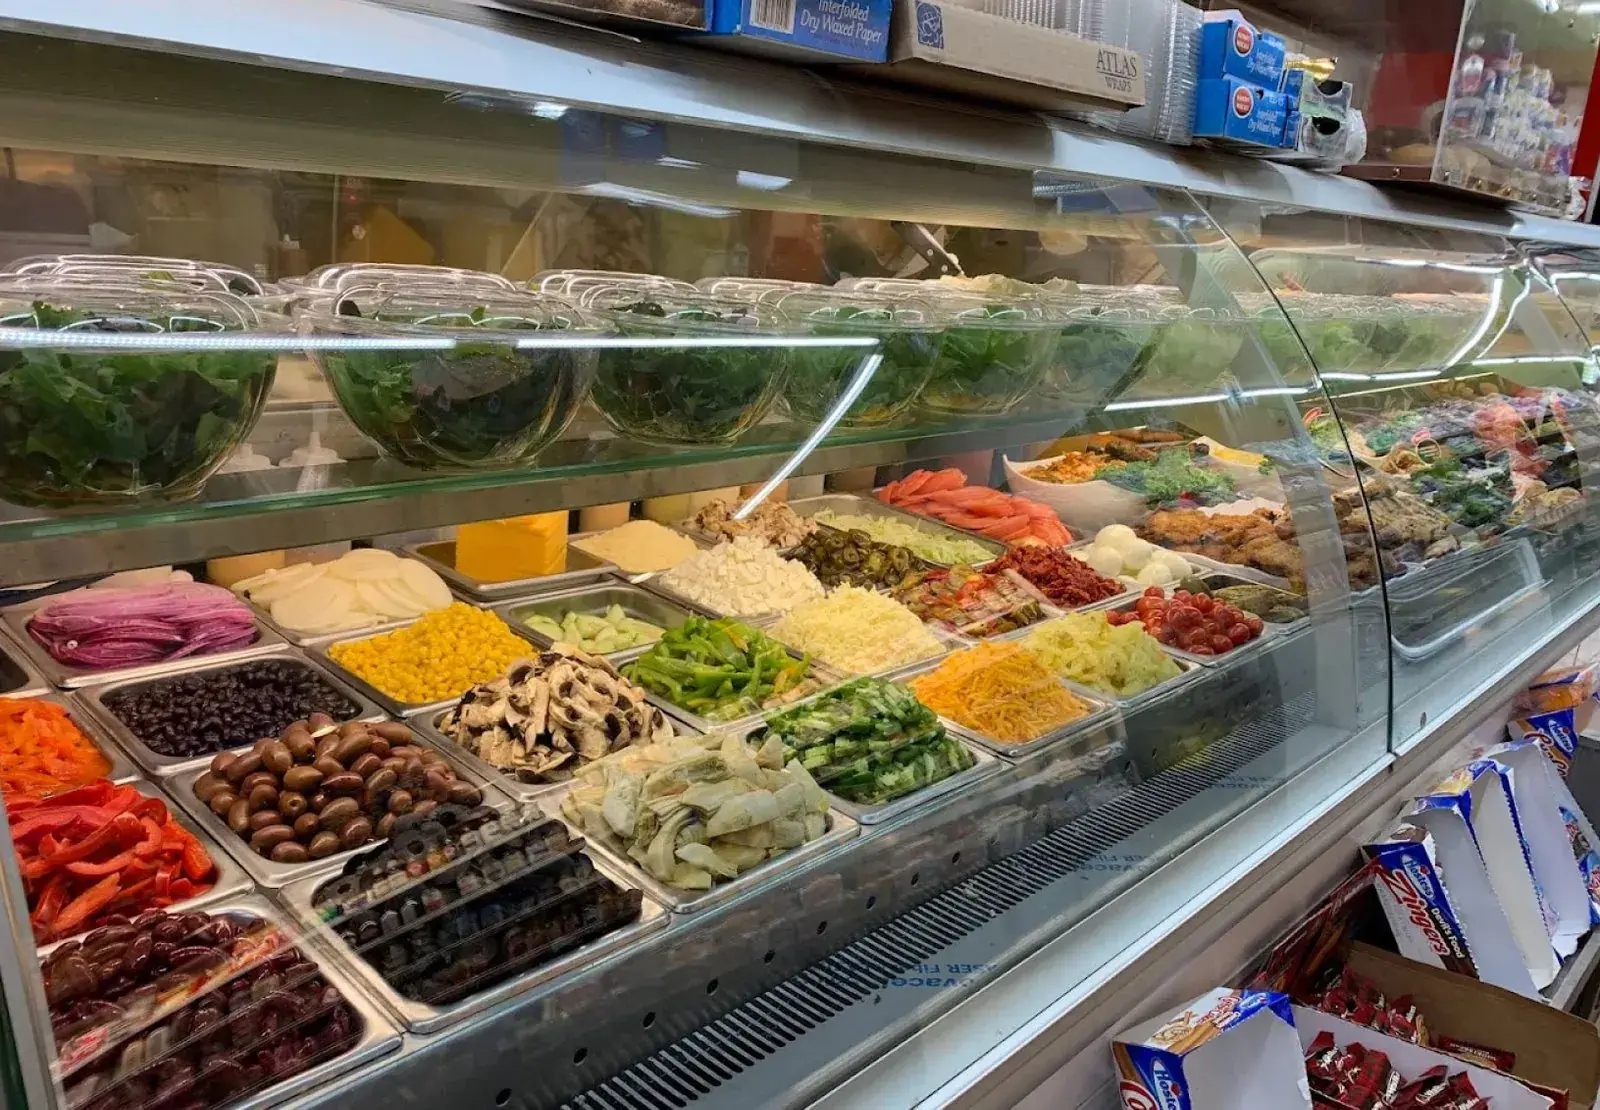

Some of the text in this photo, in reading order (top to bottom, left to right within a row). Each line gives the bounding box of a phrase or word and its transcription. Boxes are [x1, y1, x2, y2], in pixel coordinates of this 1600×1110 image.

[801, 9, 882, 45] Dry Waxed Paper
[818, 0, 869, 21] Interfolded
[1095, 48, 1137, 78] ATLAS
[1104, 76, 1132, 92] WRAPS
[1403, 859, 1433, 898] Hostess
[1376, 867, 1450, 956] Zingers
[1431, 906, 1466, 959] Devil's Food
[1154, 1069, 1178, 1110] Hoste
